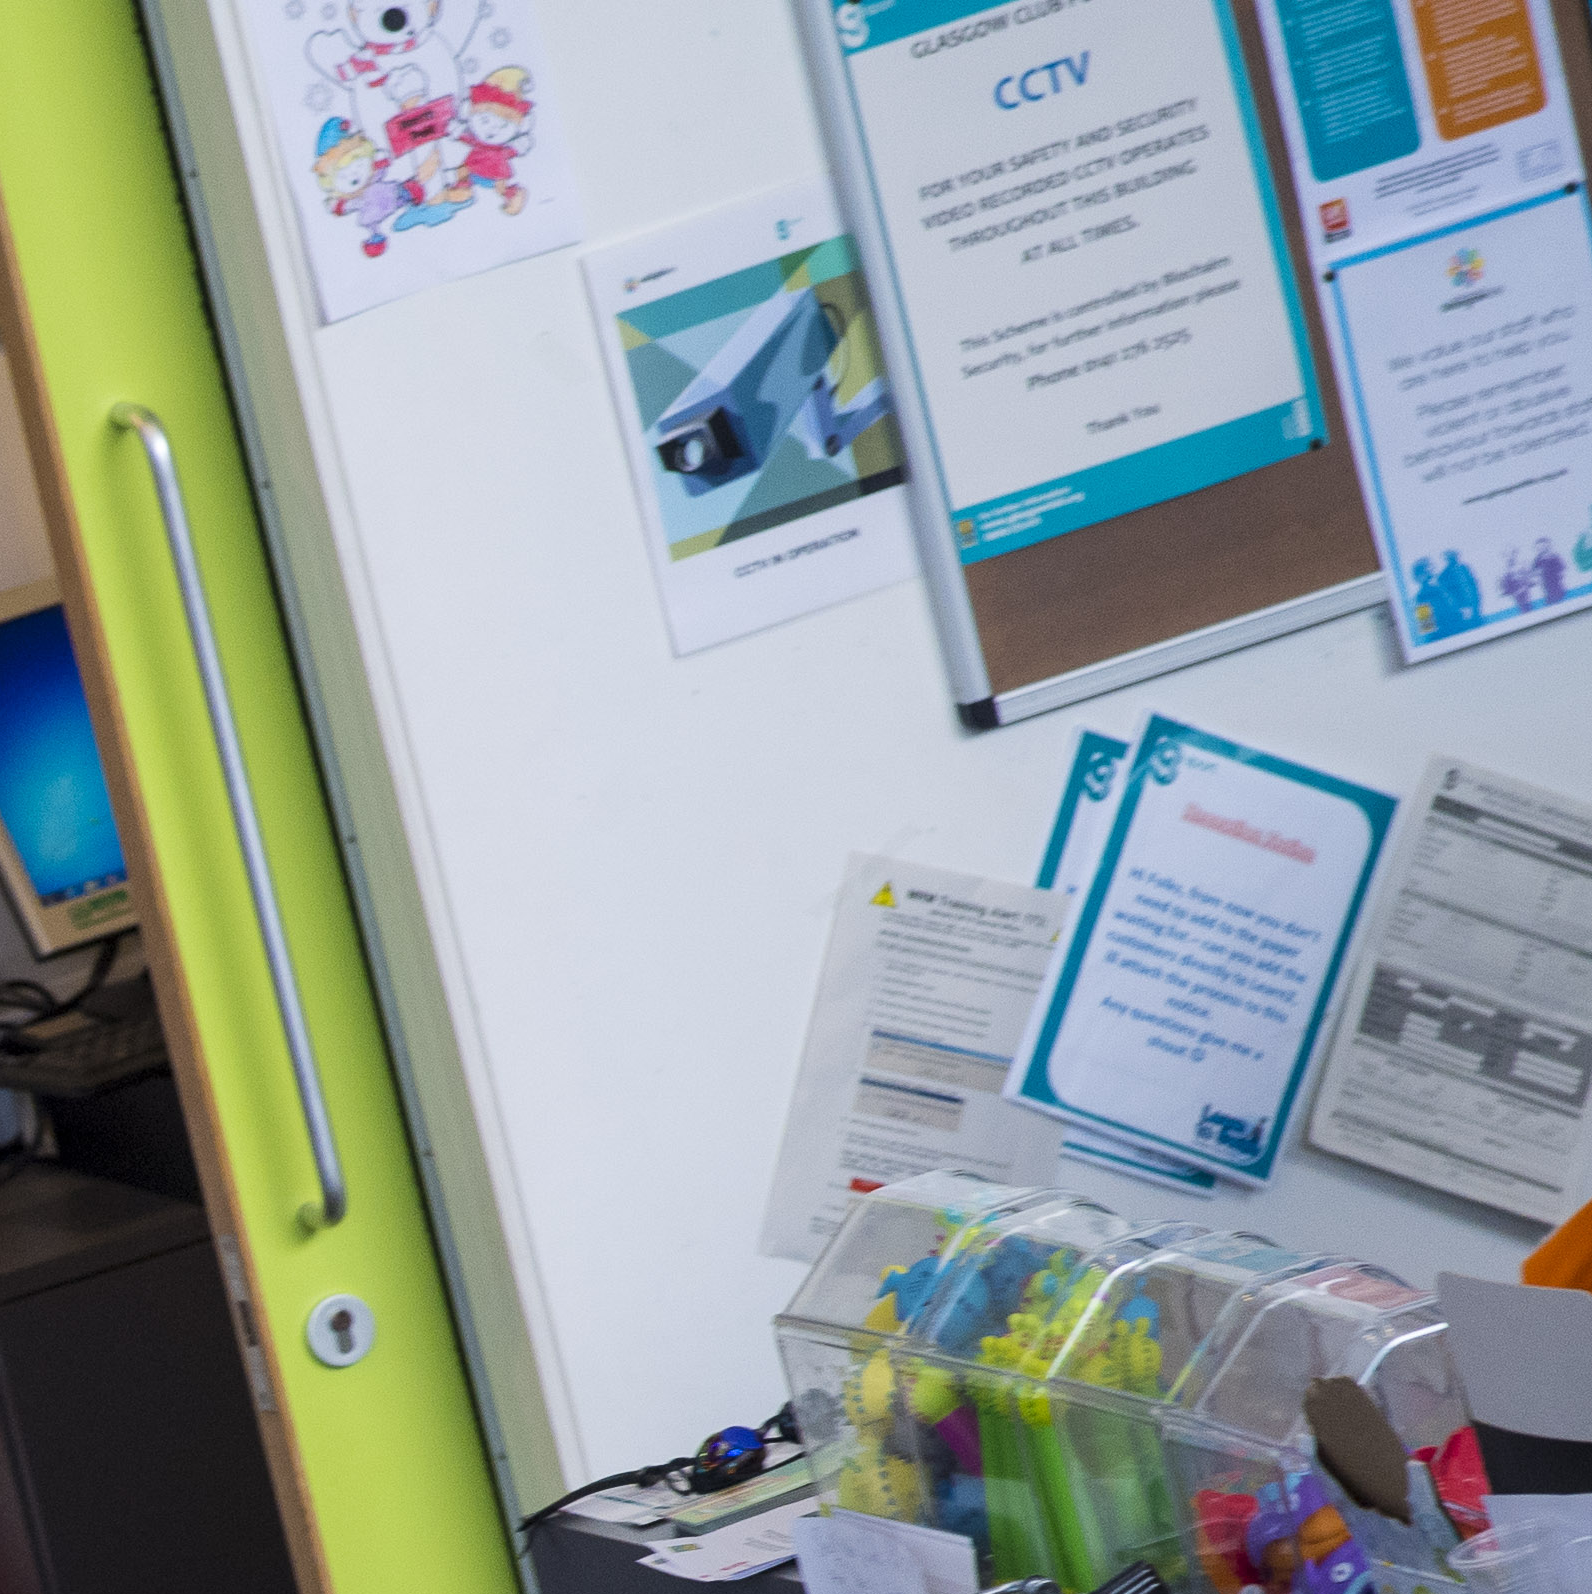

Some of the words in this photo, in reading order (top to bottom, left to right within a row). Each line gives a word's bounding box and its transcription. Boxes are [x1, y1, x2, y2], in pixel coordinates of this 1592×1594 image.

[993, 50, 1091, 110] CCTV
[958, 160, 1006, 188] YOUR
[1008, 139, 1071, 172] SAFETY
[1076, 125, 1113, 147] AND
[1116, 98, 1199, 136] SECURITY
[978, 170, 1070, 210] RECORDED
[1119, 124, 1210, 165] OPERATES
[949, 201, 1068, 250] THROUGHOUT
[1114, 158, 1199, 197] BUILDING
